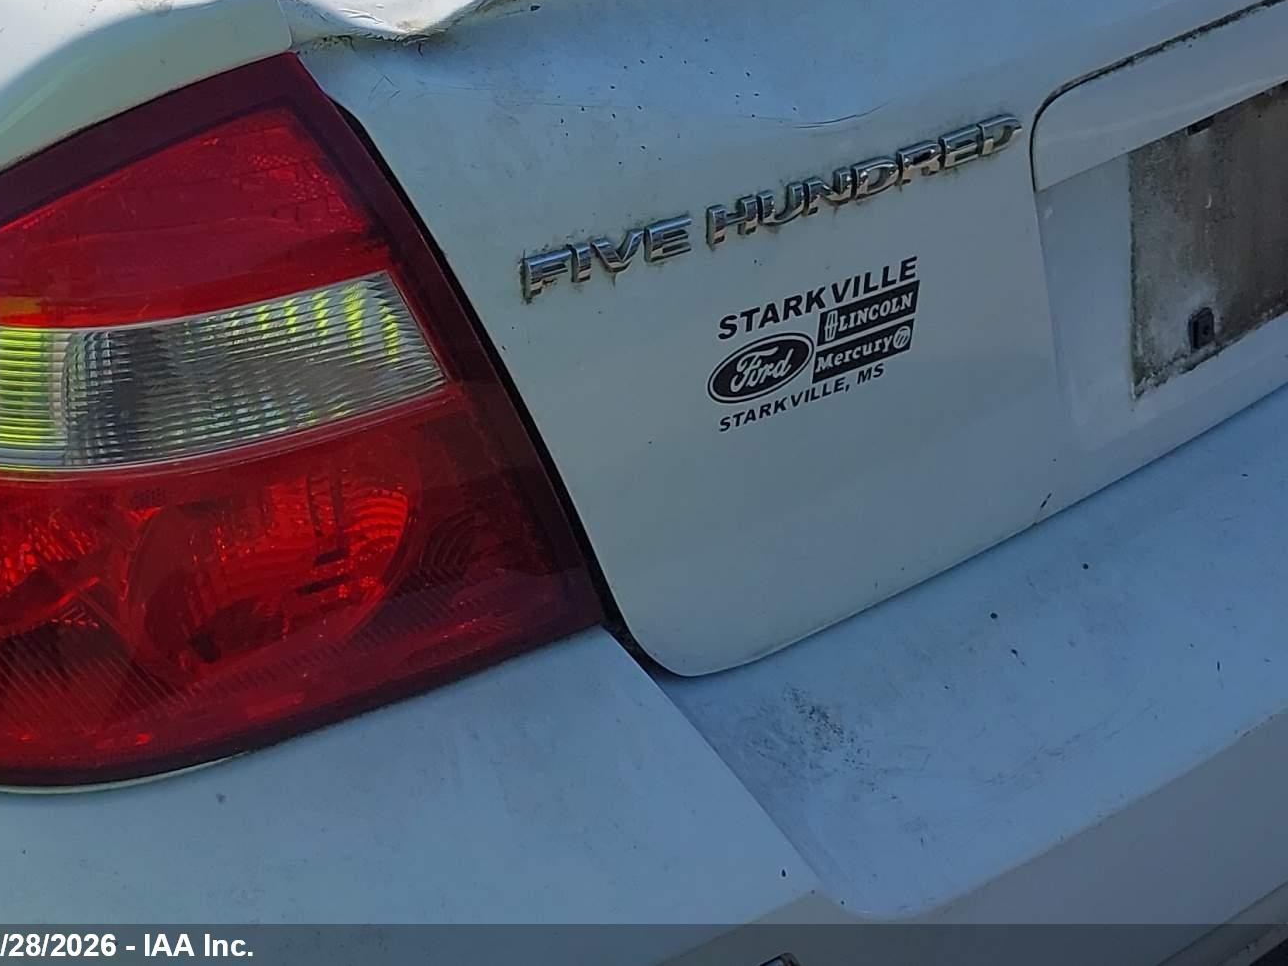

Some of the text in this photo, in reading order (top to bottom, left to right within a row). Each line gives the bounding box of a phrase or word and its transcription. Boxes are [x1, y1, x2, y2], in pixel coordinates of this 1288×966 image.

[521, 113, 1022, 303] FIVE HUNDRED
[718, 256, 917, 340] STARKVILLE
[837, 291, 914, 332] LINCOLN
[729, 346, 794, 393] Ford
[815, 335, 893, 373] Mercury
[719, 363, 885, 432] STARKVILLE, MS
